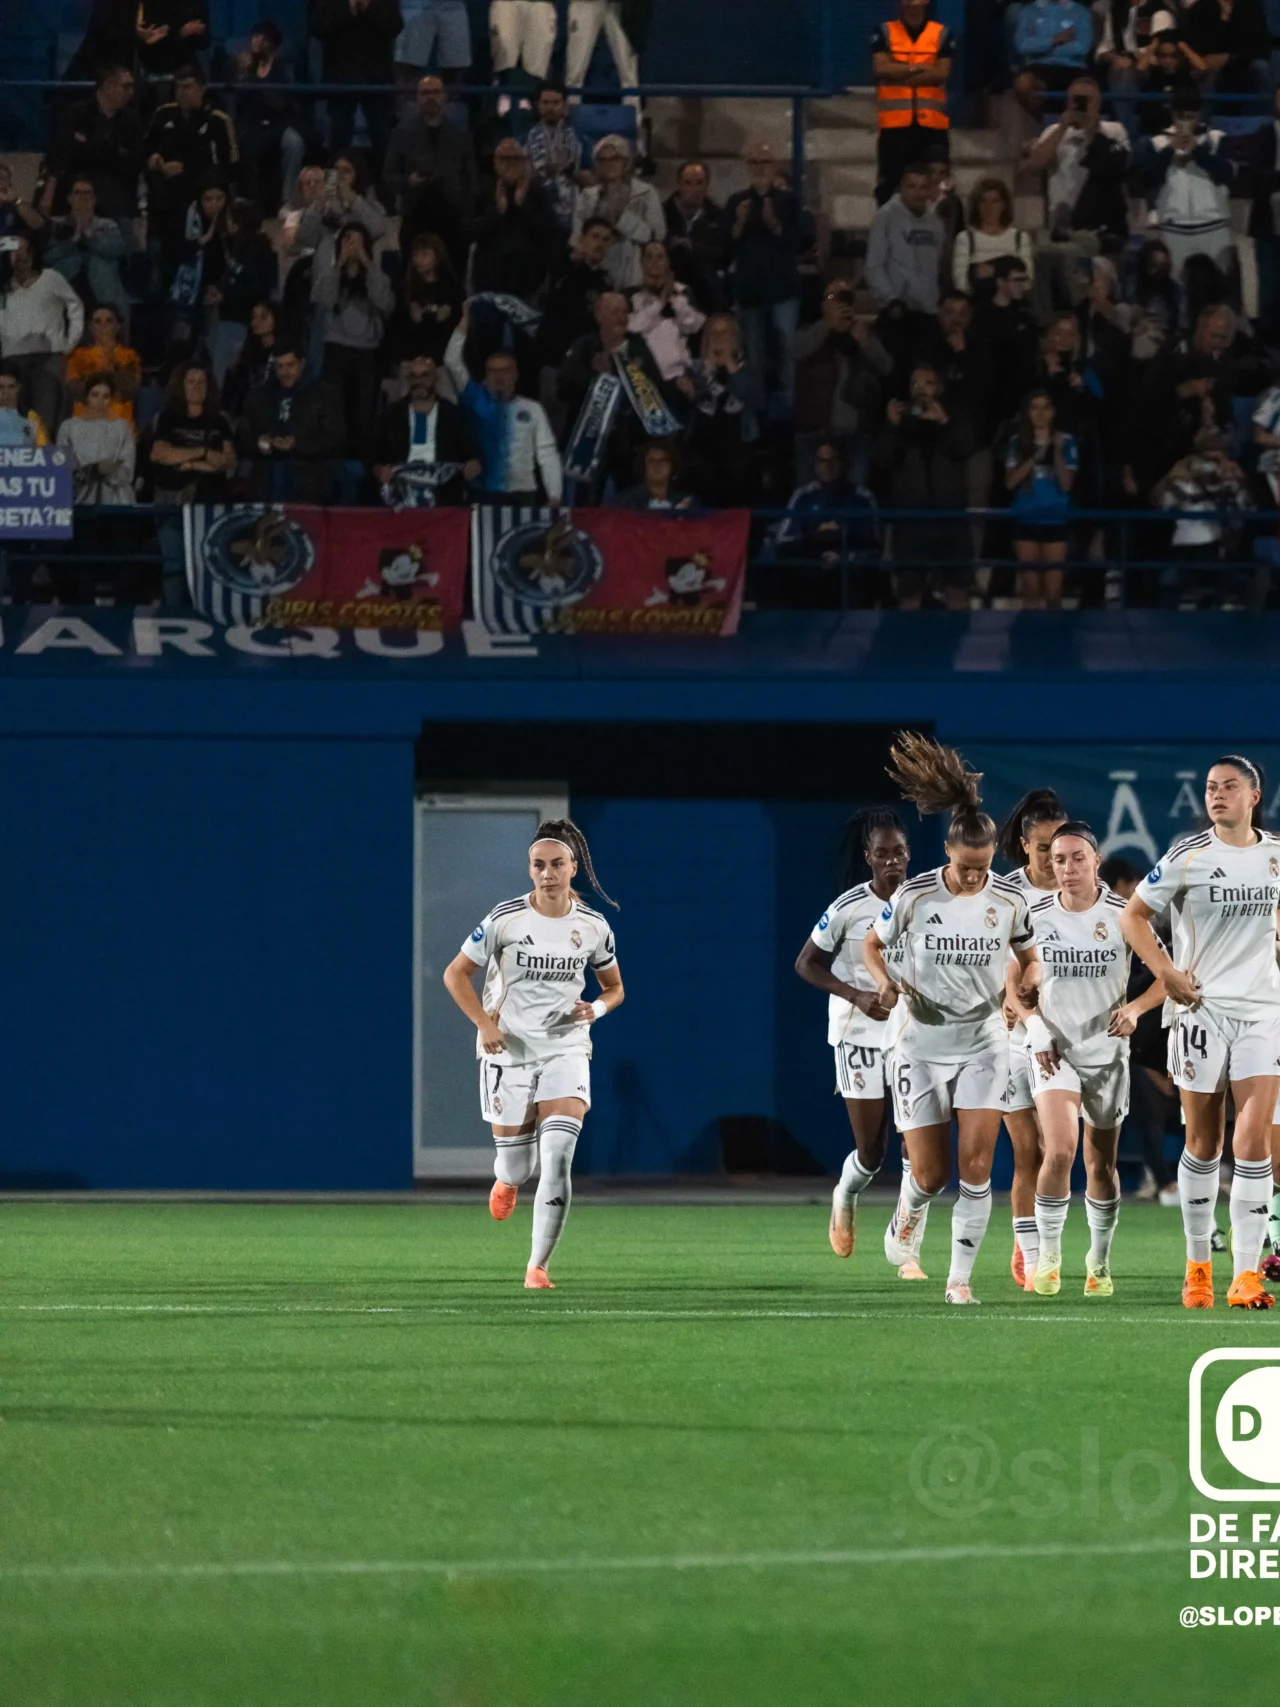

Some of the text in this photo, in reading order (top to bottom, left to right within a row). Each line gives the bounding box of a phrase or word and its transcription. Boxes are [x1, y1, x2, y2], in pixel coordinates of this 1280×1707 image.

[27, 476, 55, 498] TU
[0, 617, 539, 658] ARQUE
[1209, 885, 1279, 903] Emirates
[1221, 903, 1273, 918] FLY BETTER
[925, 934, 1001, 952] Emirates
[516, 951, 585, 970] Emirates
[935, 953, 991, 967] FLY BETTER
[1043, 947, 1117, 964] Emirates
[525, 970, 576, 982] FLY BETTER
[1053, 965, 1107, 978] FLY BETTER
[1180, 1022, 1207, 1059] 14
[848, 1047, 875, 1070] 20
[490, 1063, 503, 1094] 7
[898, 1064, 911, 1097] 6
